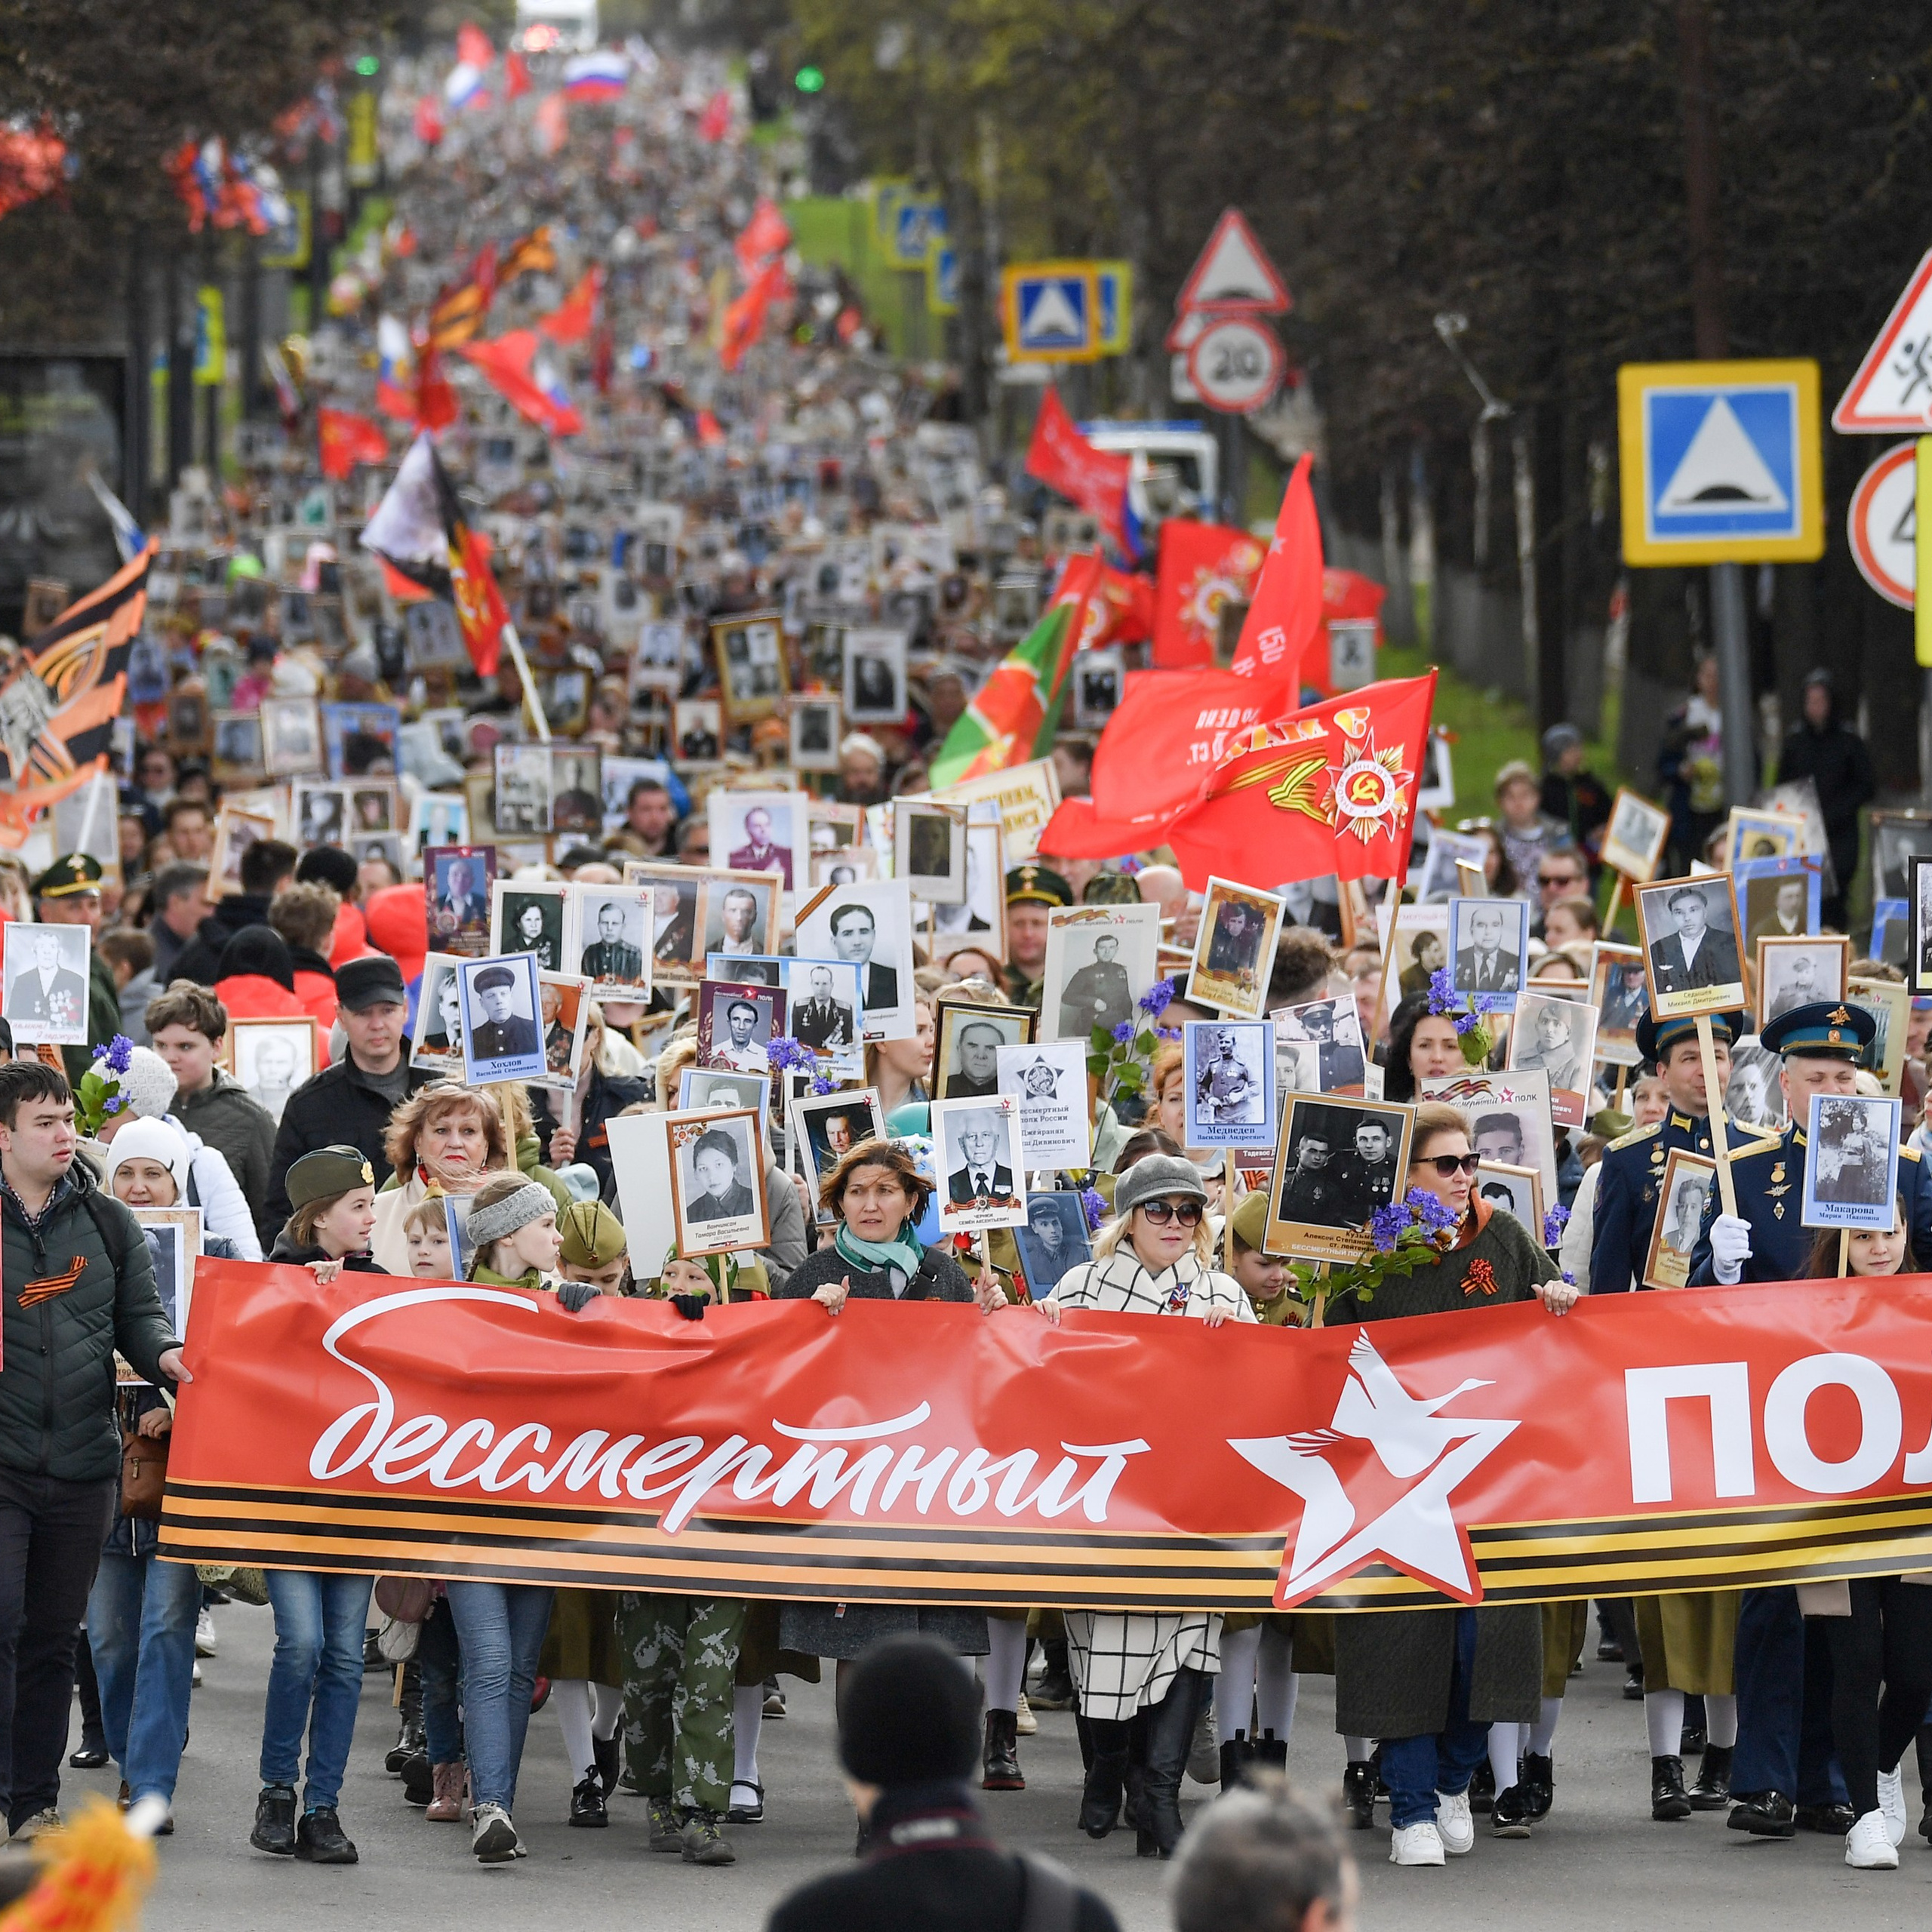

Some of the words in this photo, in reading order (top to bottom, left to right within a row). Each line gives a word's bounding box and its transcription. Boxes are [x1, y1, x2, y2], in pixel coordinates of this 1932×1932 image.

[1214, 341, 1263, 383] 20
[491, 1059, 522, 1069] Хохлов
[475, 1069, 503, 1078] Василий
[503, 1064, 538, 1075] Семенович
[1020, 1105, 1069, 1117] ессмертный
[1039, 1115, 1069, 1123] России
[1208, 1126, 1256, 1135] Медведев
[1825, 1204, 1875, 1215] Макарова
[695, 1230, 717, 1239] Тамара
[717, 1226, 750, 1235] Васильевна
[1303, 1232, 1334, 1241] Алексей
[1291, 1244, 1346, 1256] БЕССМЕРТНЫЙ
[1624, 1352, 1932, 1504] ПО
